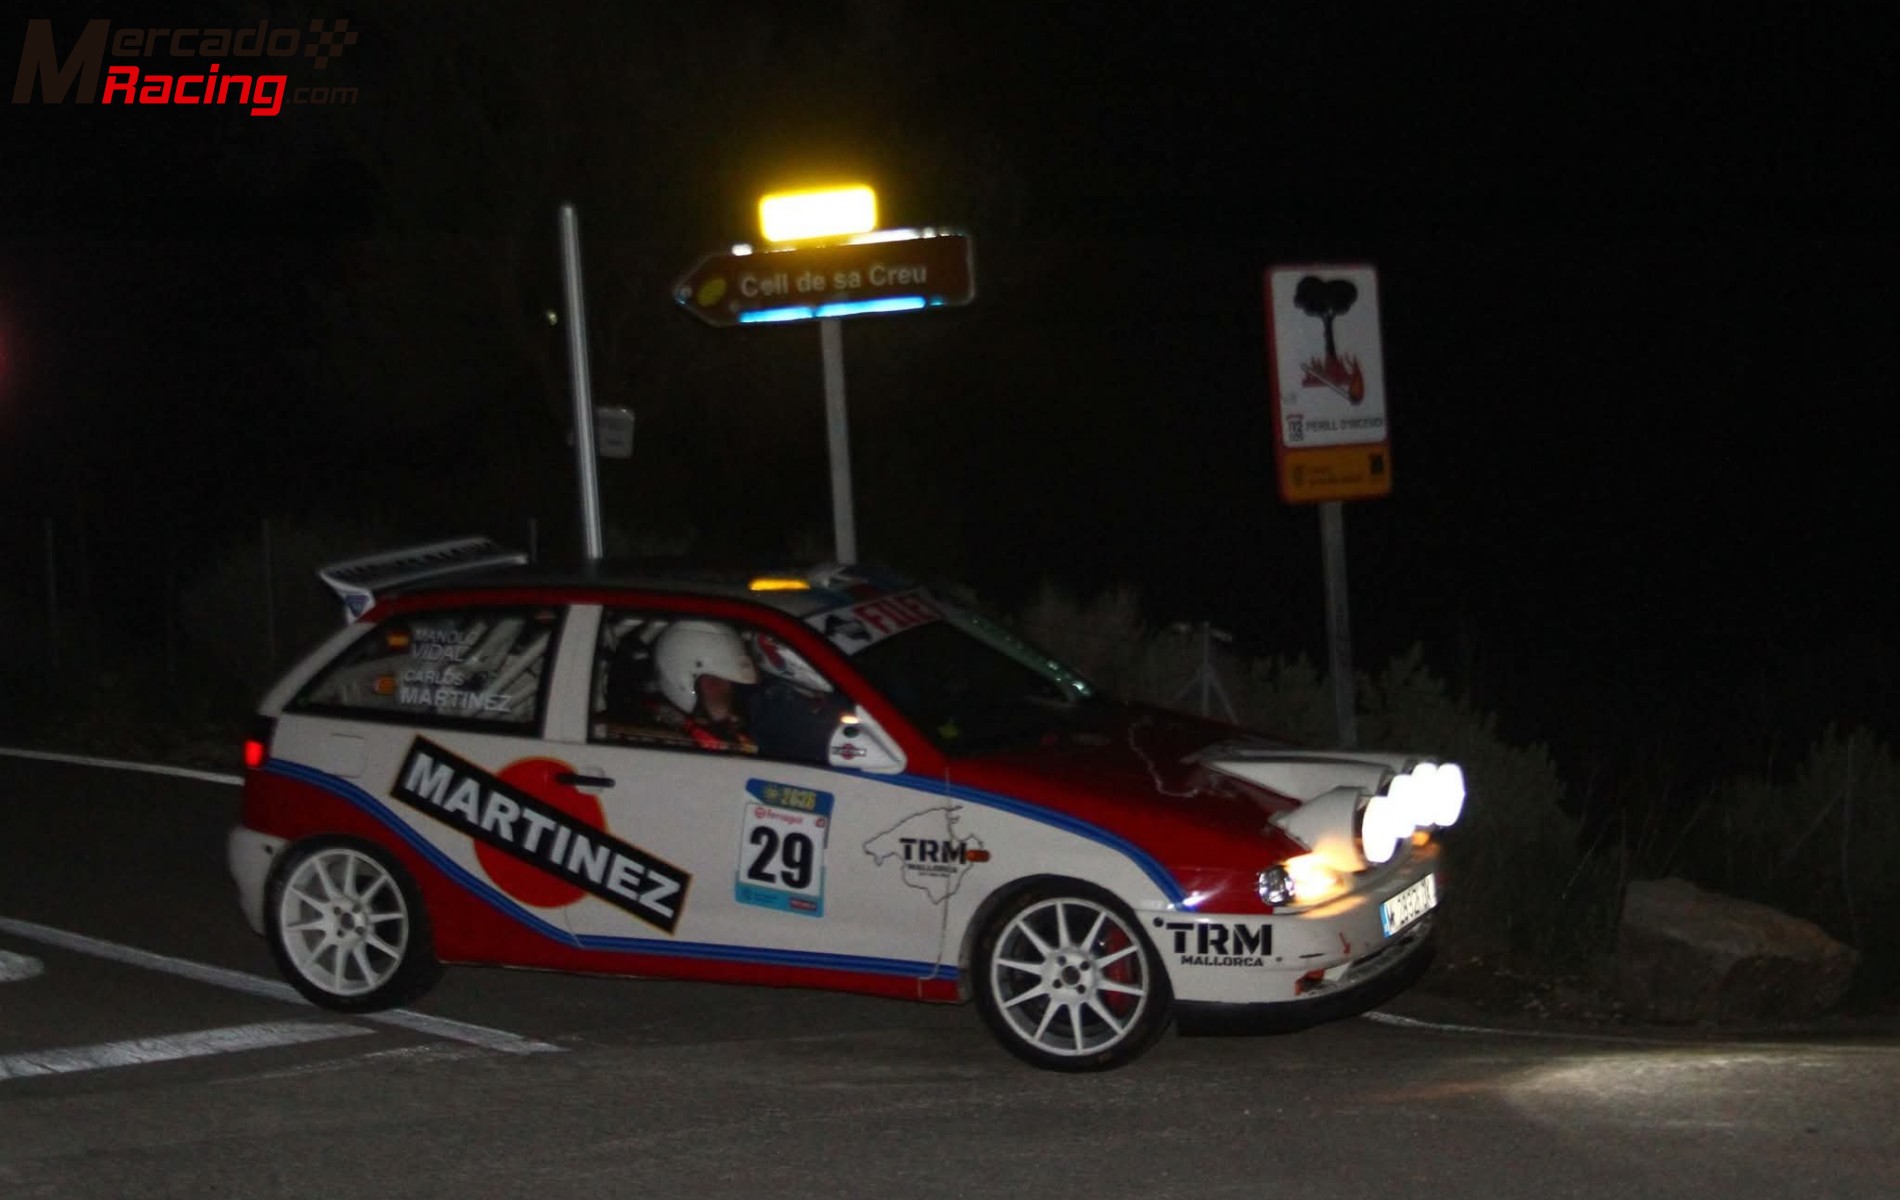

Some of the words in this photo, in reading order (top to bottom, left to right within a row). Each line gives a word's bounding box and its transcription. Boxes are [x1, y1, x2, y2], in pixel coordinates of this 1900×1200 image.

[796, 270, 826, 294] de
[834, 268, 863, 290] sa
[868, 263, 928, 289] Creu
[411, 642, 472, 663] VIDAL
[402, 669, 466, 686] CARLOS
[399, 686, 513, 713] MARTINEZ
[404, 751, 681, 919] MARTINEZ
[747, 824, 814, 890] 29
[899, 837, 967, 865] TRM
[1165, 920, 1273, 956] TRM
[1180, 954, 1265, 968] MALLORCA
